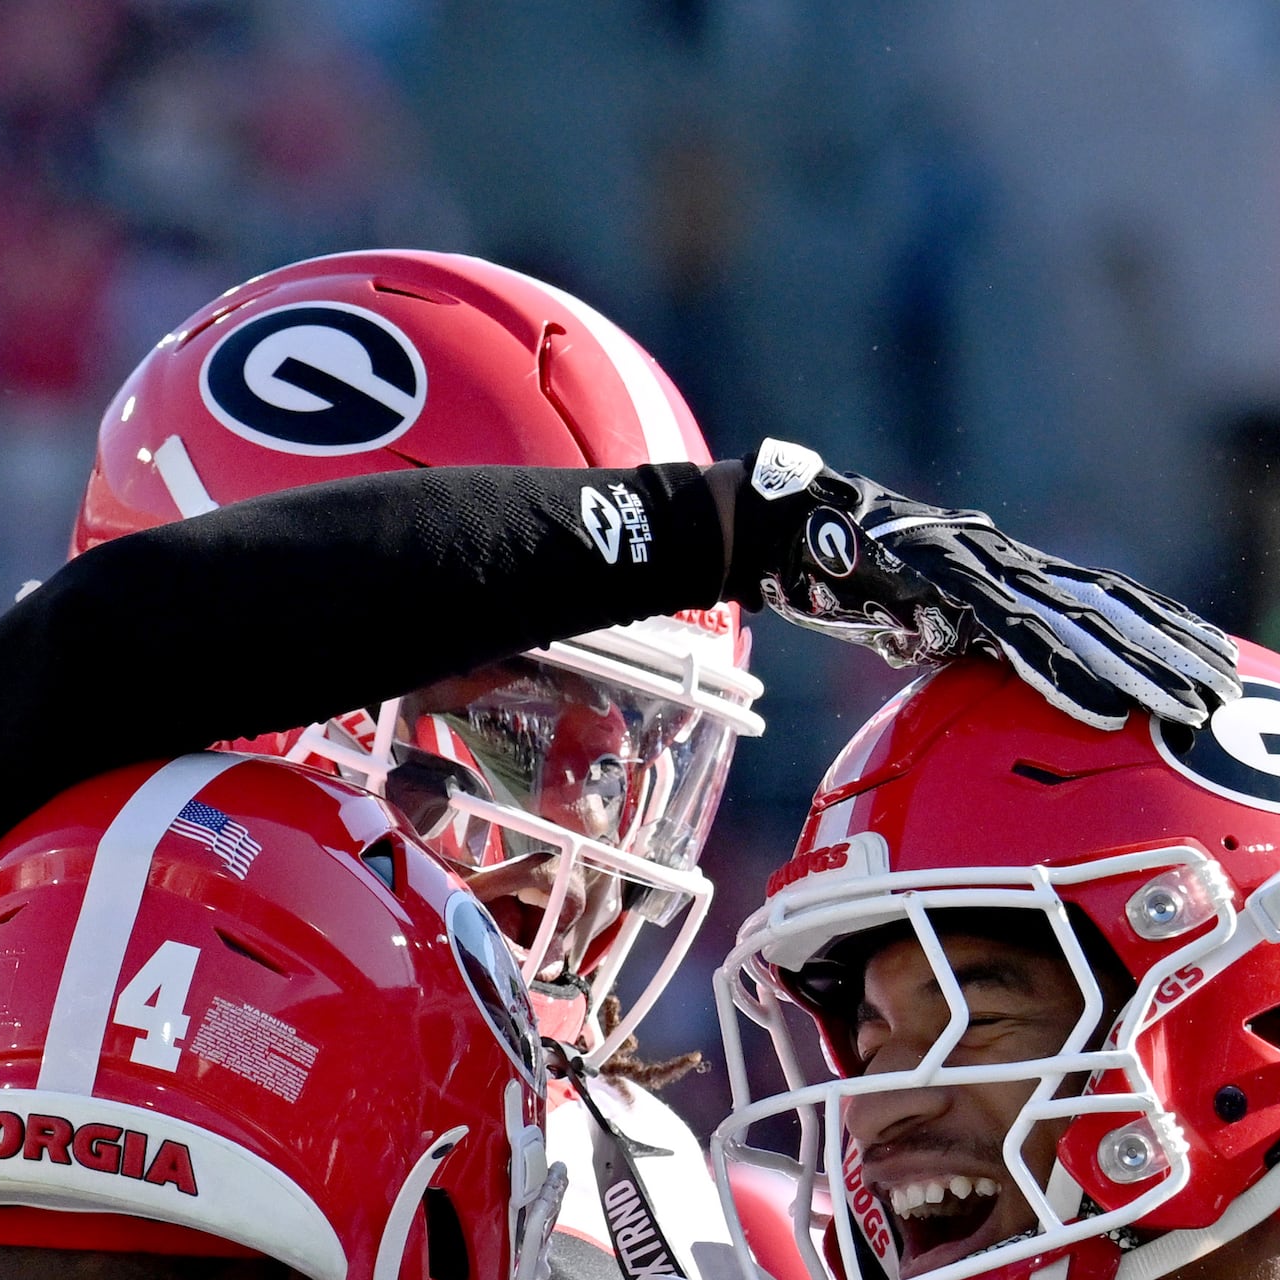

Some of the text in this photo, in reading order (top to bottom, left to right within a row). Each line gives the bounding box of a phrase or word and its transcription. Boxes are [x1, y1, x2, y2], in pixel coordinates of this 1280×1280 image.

[205, 304, 420, 448] G
[607, 482, 648, 563] SHOCK
[629, 493, 652, 541] DOCTOR
[113, 940, 200, 1073] 4
[243, 1003, 297, 1035] WARNING
